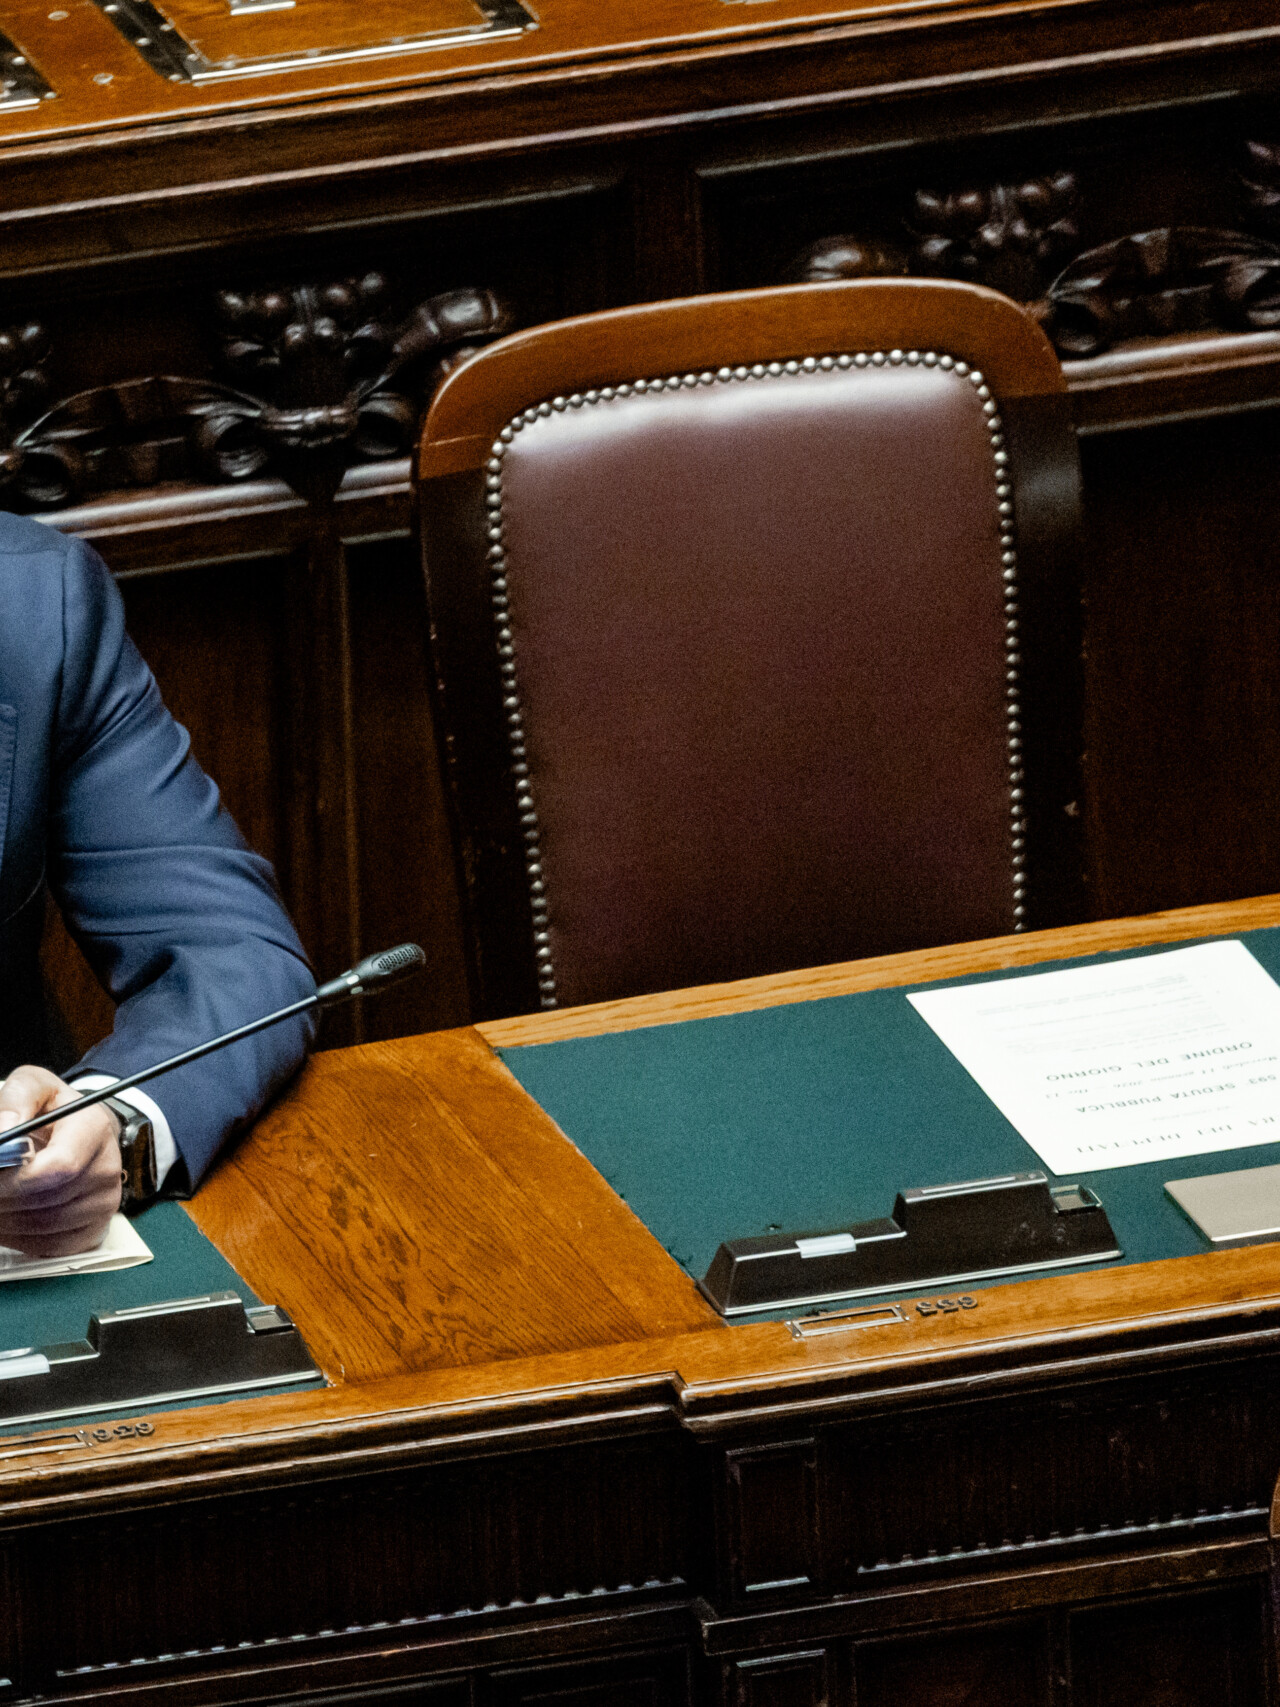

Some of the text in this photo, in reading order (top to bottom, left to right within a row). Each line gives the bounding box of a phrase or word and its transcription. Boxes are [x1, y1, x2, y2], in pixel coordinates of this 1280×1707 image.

[1045, 1041, 1252, 1081] ORDINE DEL GIORNO
[1170, 1081, 1235, 1100] SEDUTA
[1074, 1095, 1161, 1114] PUBBLICA
